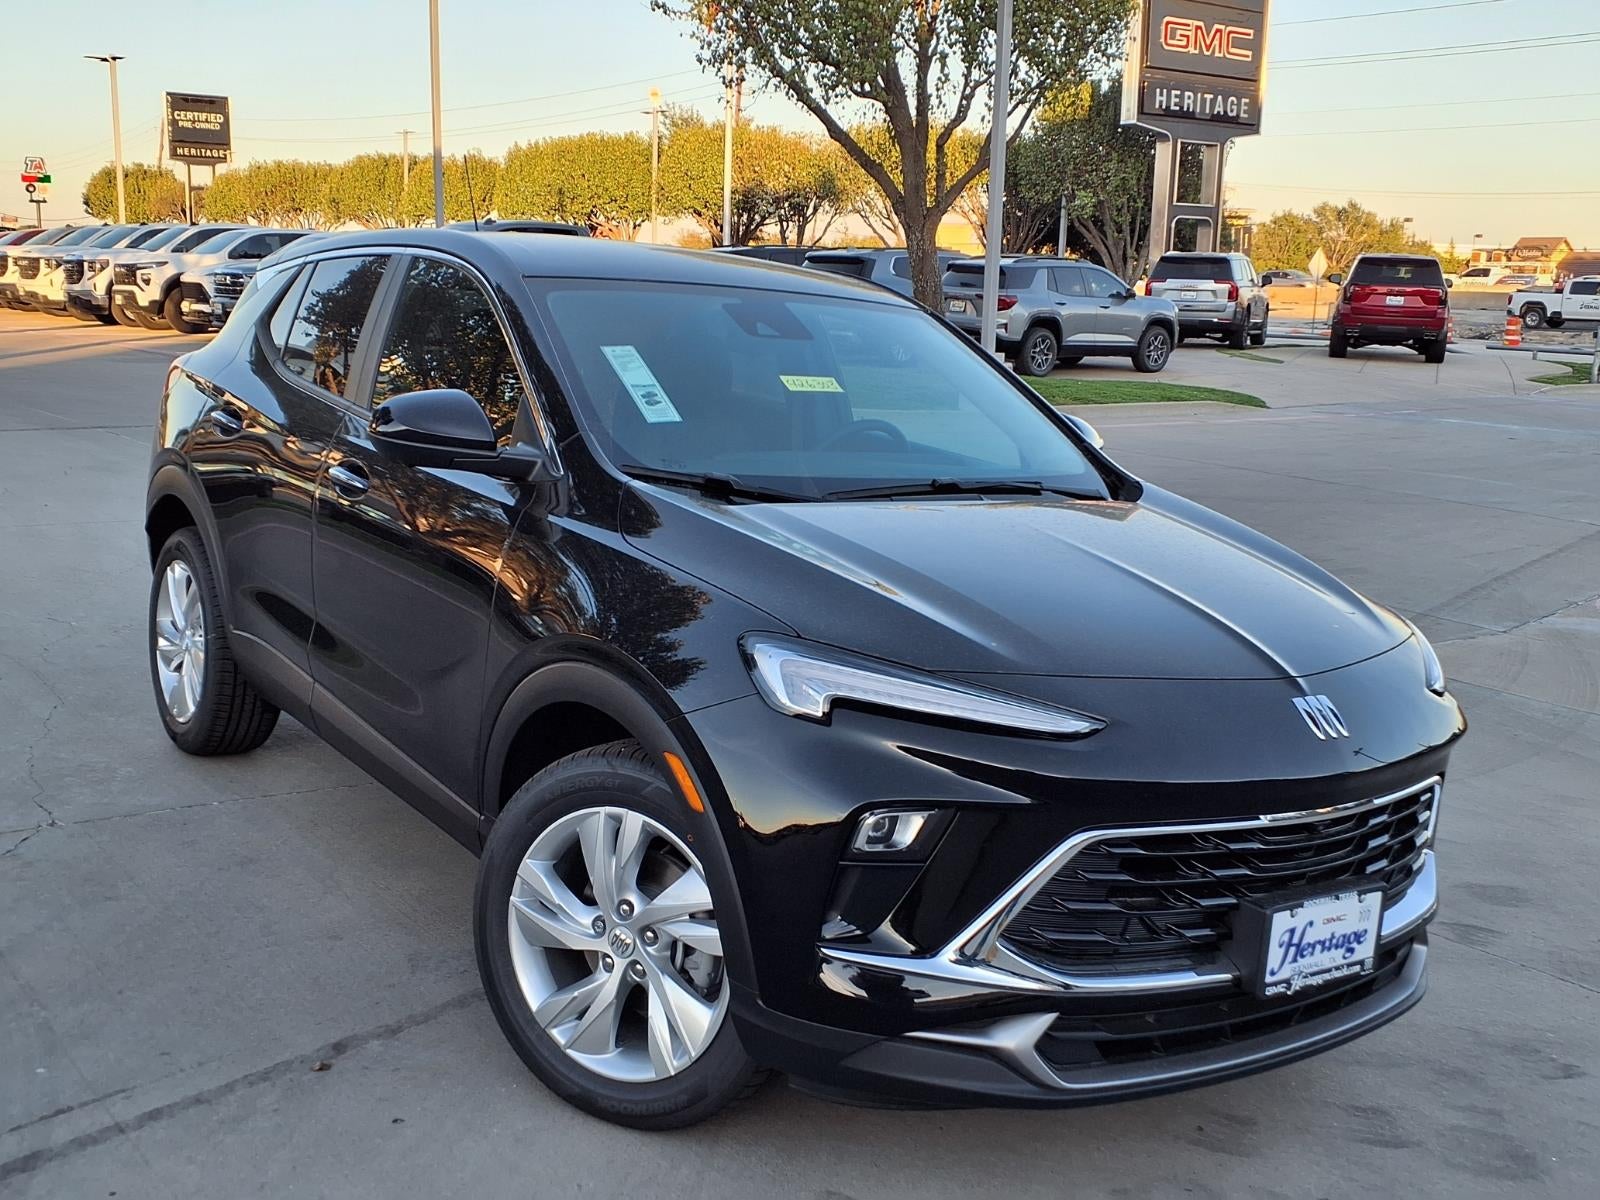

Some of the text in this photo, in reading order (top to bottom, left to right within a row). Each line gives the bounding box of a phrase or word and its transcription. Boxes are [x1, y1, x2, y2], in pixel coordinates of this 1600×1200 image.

[1162, 16, 1254, 61] GMC
[1155, 88, 1250, 118] HERITAGE
[174, 111, 224, 123] CERTIFIED
[178, 121, 221, 131] PRE-OWNED
[177, 147, 226, 158] HERITAGE
[26, 158, 45, 172] TA
[1322, 914, 1348, 926] GMC
[1269, 920, 1368, 977] Heritage
[1265, 983, 1288, 996] GMC
